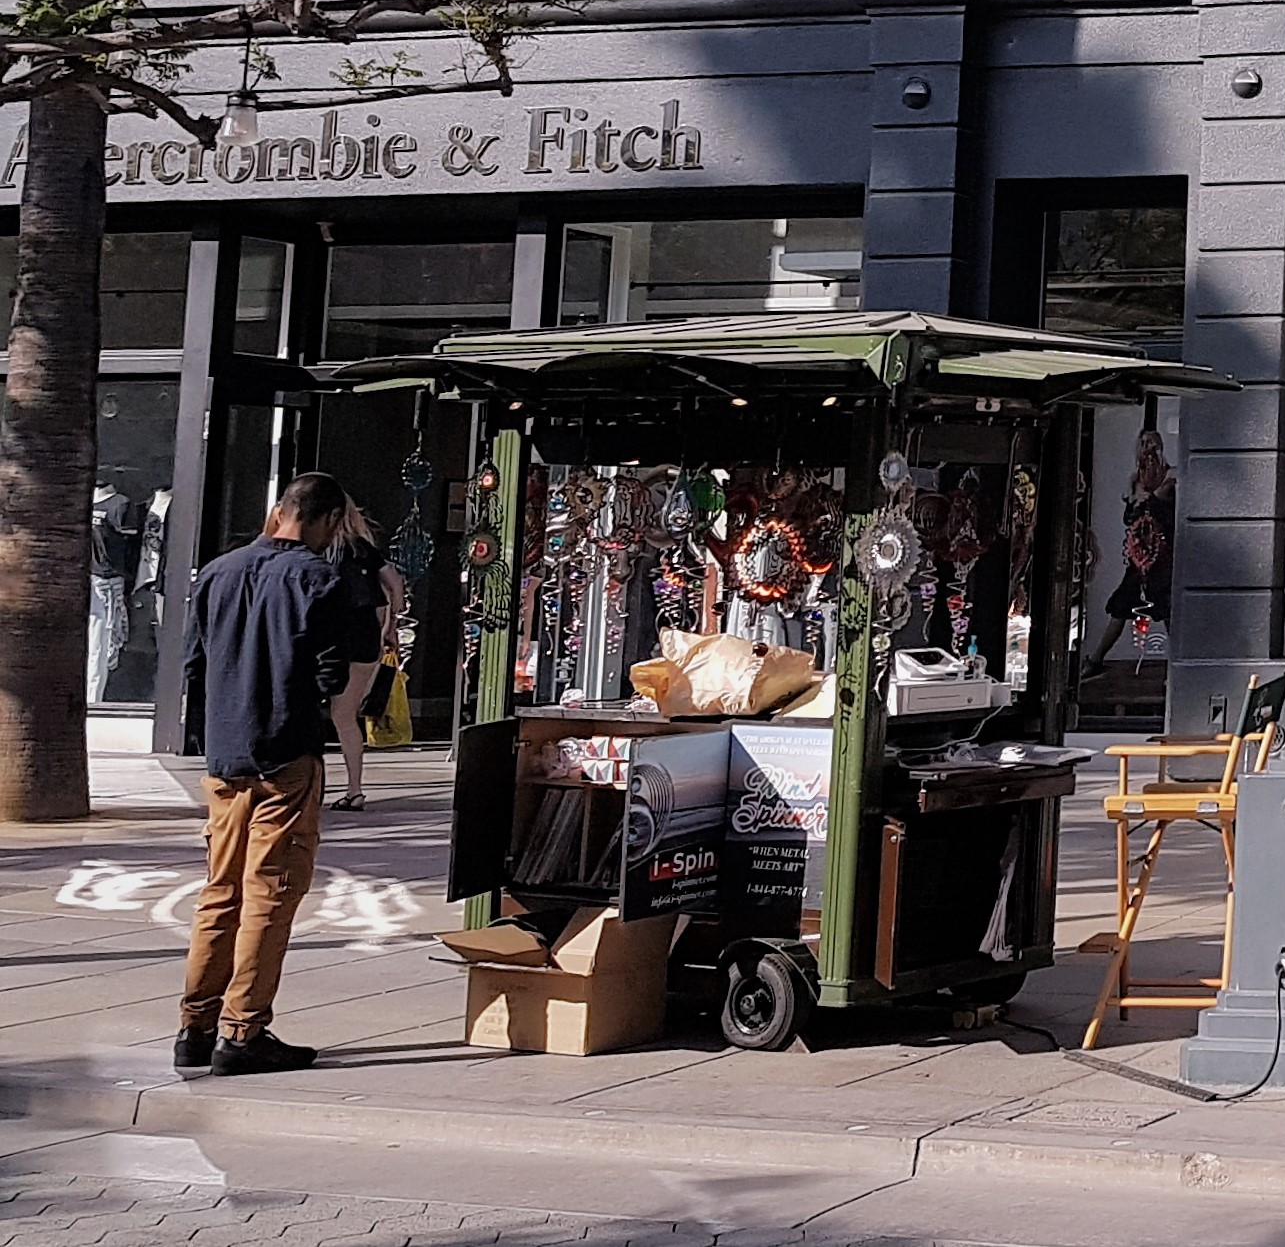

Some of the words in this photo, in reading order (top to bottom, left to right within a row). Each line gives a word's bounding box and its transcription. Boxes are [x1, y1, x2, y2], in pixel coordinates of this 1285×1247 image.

[0, 110, 417, 189] ercrombie
[441, 122, 500, 177] &
[523, 99, 704, 174] Fitch
[744, 763, 822, 803] Wind
[653, 847, 715, 876] i-Spin
[751, 860, 782, 871] MEETS
[780, 847, 810, 859] METAL
